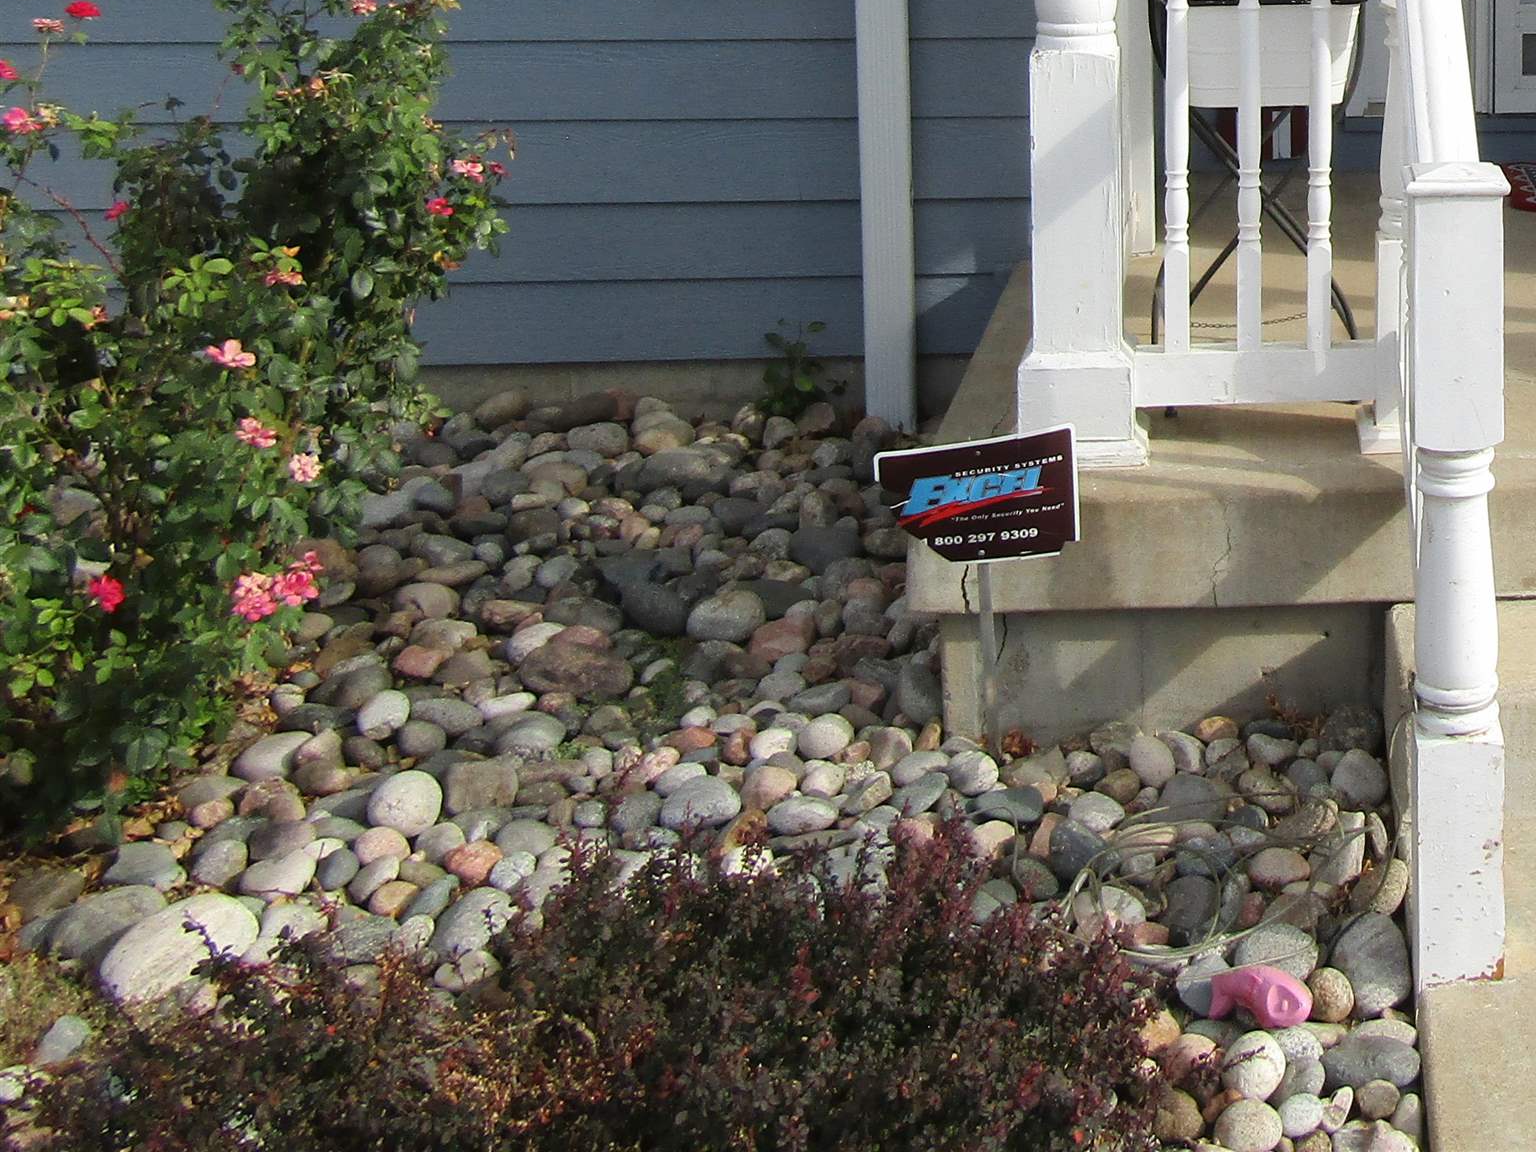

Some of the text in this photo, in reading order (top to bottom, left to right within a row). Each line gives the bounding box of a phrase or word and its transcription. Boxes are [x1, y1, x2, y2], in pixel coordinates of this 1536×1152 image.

[955, 454, 1064, 478] SECURITY SYSTEMS
[900, 465, 1043, 516] EXCEL
[991, 508, 1023, 519] Security
[934, 535, 963, 546] 800
[967, 532, 996, 544] 297
[1000, 527, 1039, 541] 9309
